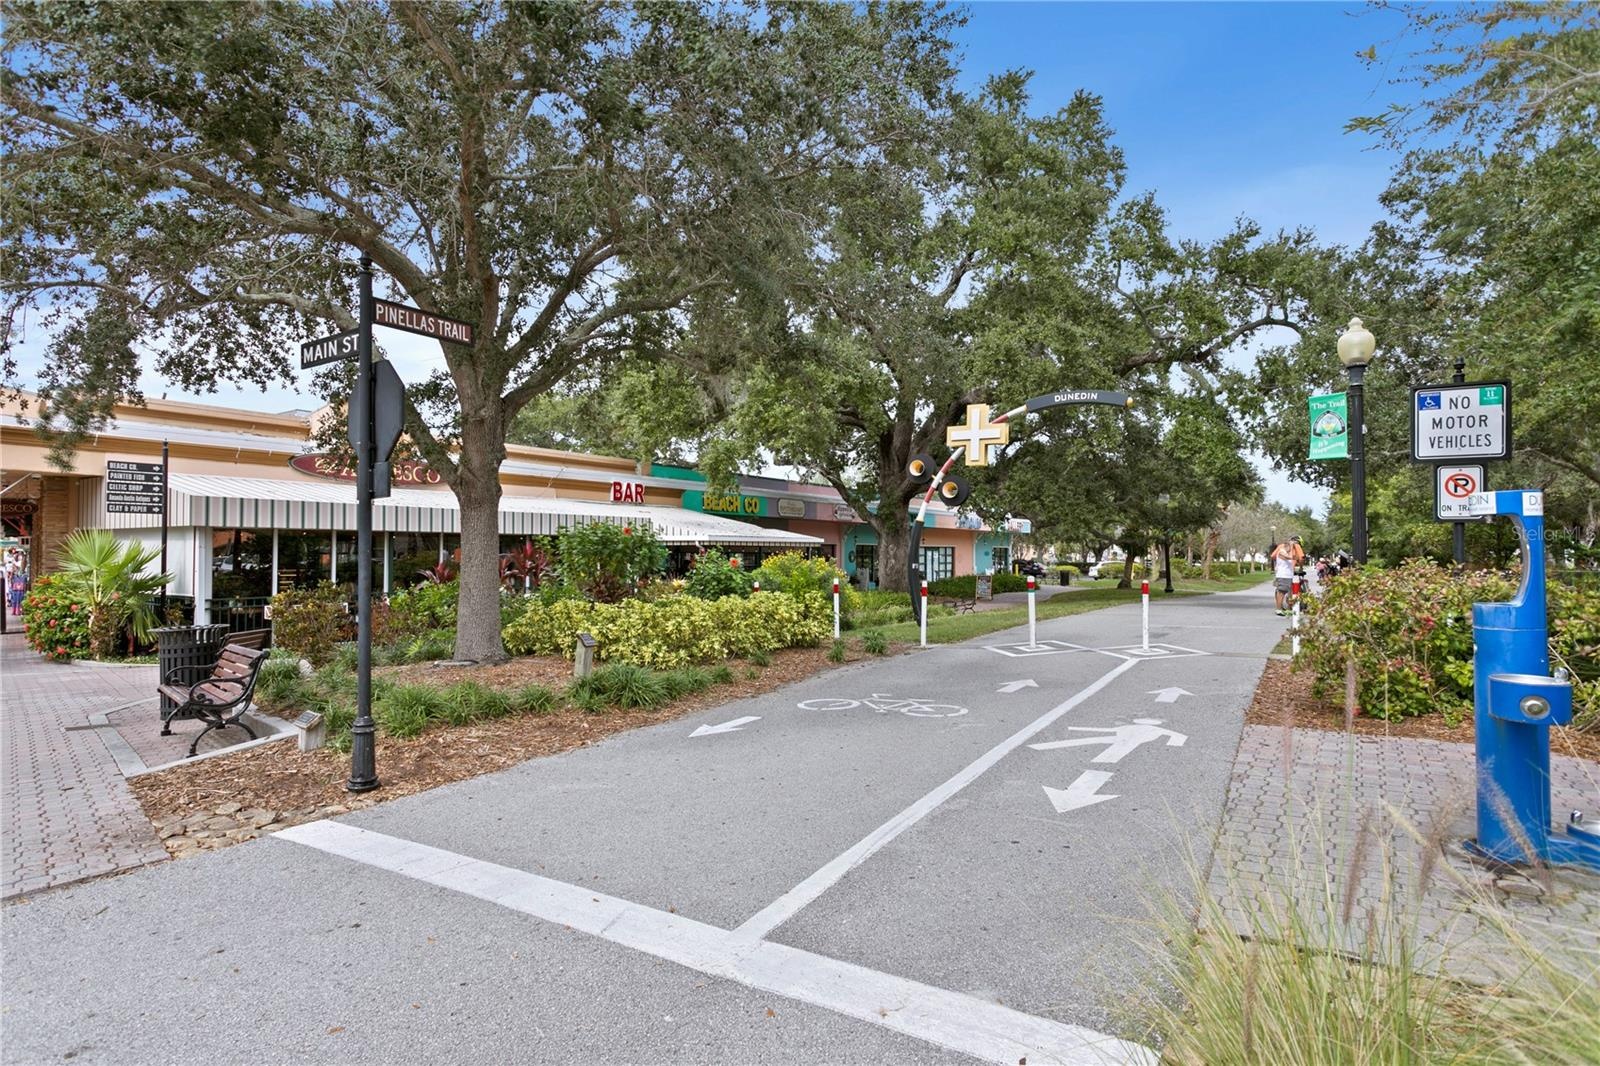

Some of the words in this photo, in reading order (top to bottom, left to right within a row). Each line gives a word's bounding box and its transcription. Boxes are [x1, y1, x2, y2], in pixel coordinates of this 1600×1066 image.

[375, 304, 435, 334] PINELLAS
[437, 320, 470, 342] TRAIL
[303, 341, 338, 364] MAIN
[342, 334, 360, 353] ST
[1054, 392, 1098, 403] DUNEDIN
[1312, 402, 1327, 410] The
[1328, 399, 1345, 408] Trail
[1449, 396, 1471, 410] NO
[1432, 414, 1489, 430] MOTOR
[1429, 433, 1492, 449] VEHICLES
[109, 472, 133, 480] PAINTED
[109, 483, 127, 491] CELTIC
[612, 481, 645, 504] BAR
[0, 503, 33, 513] ESCO
[703, 495, 740, 512] BEACH
[744, 496, 759, 513] CO
